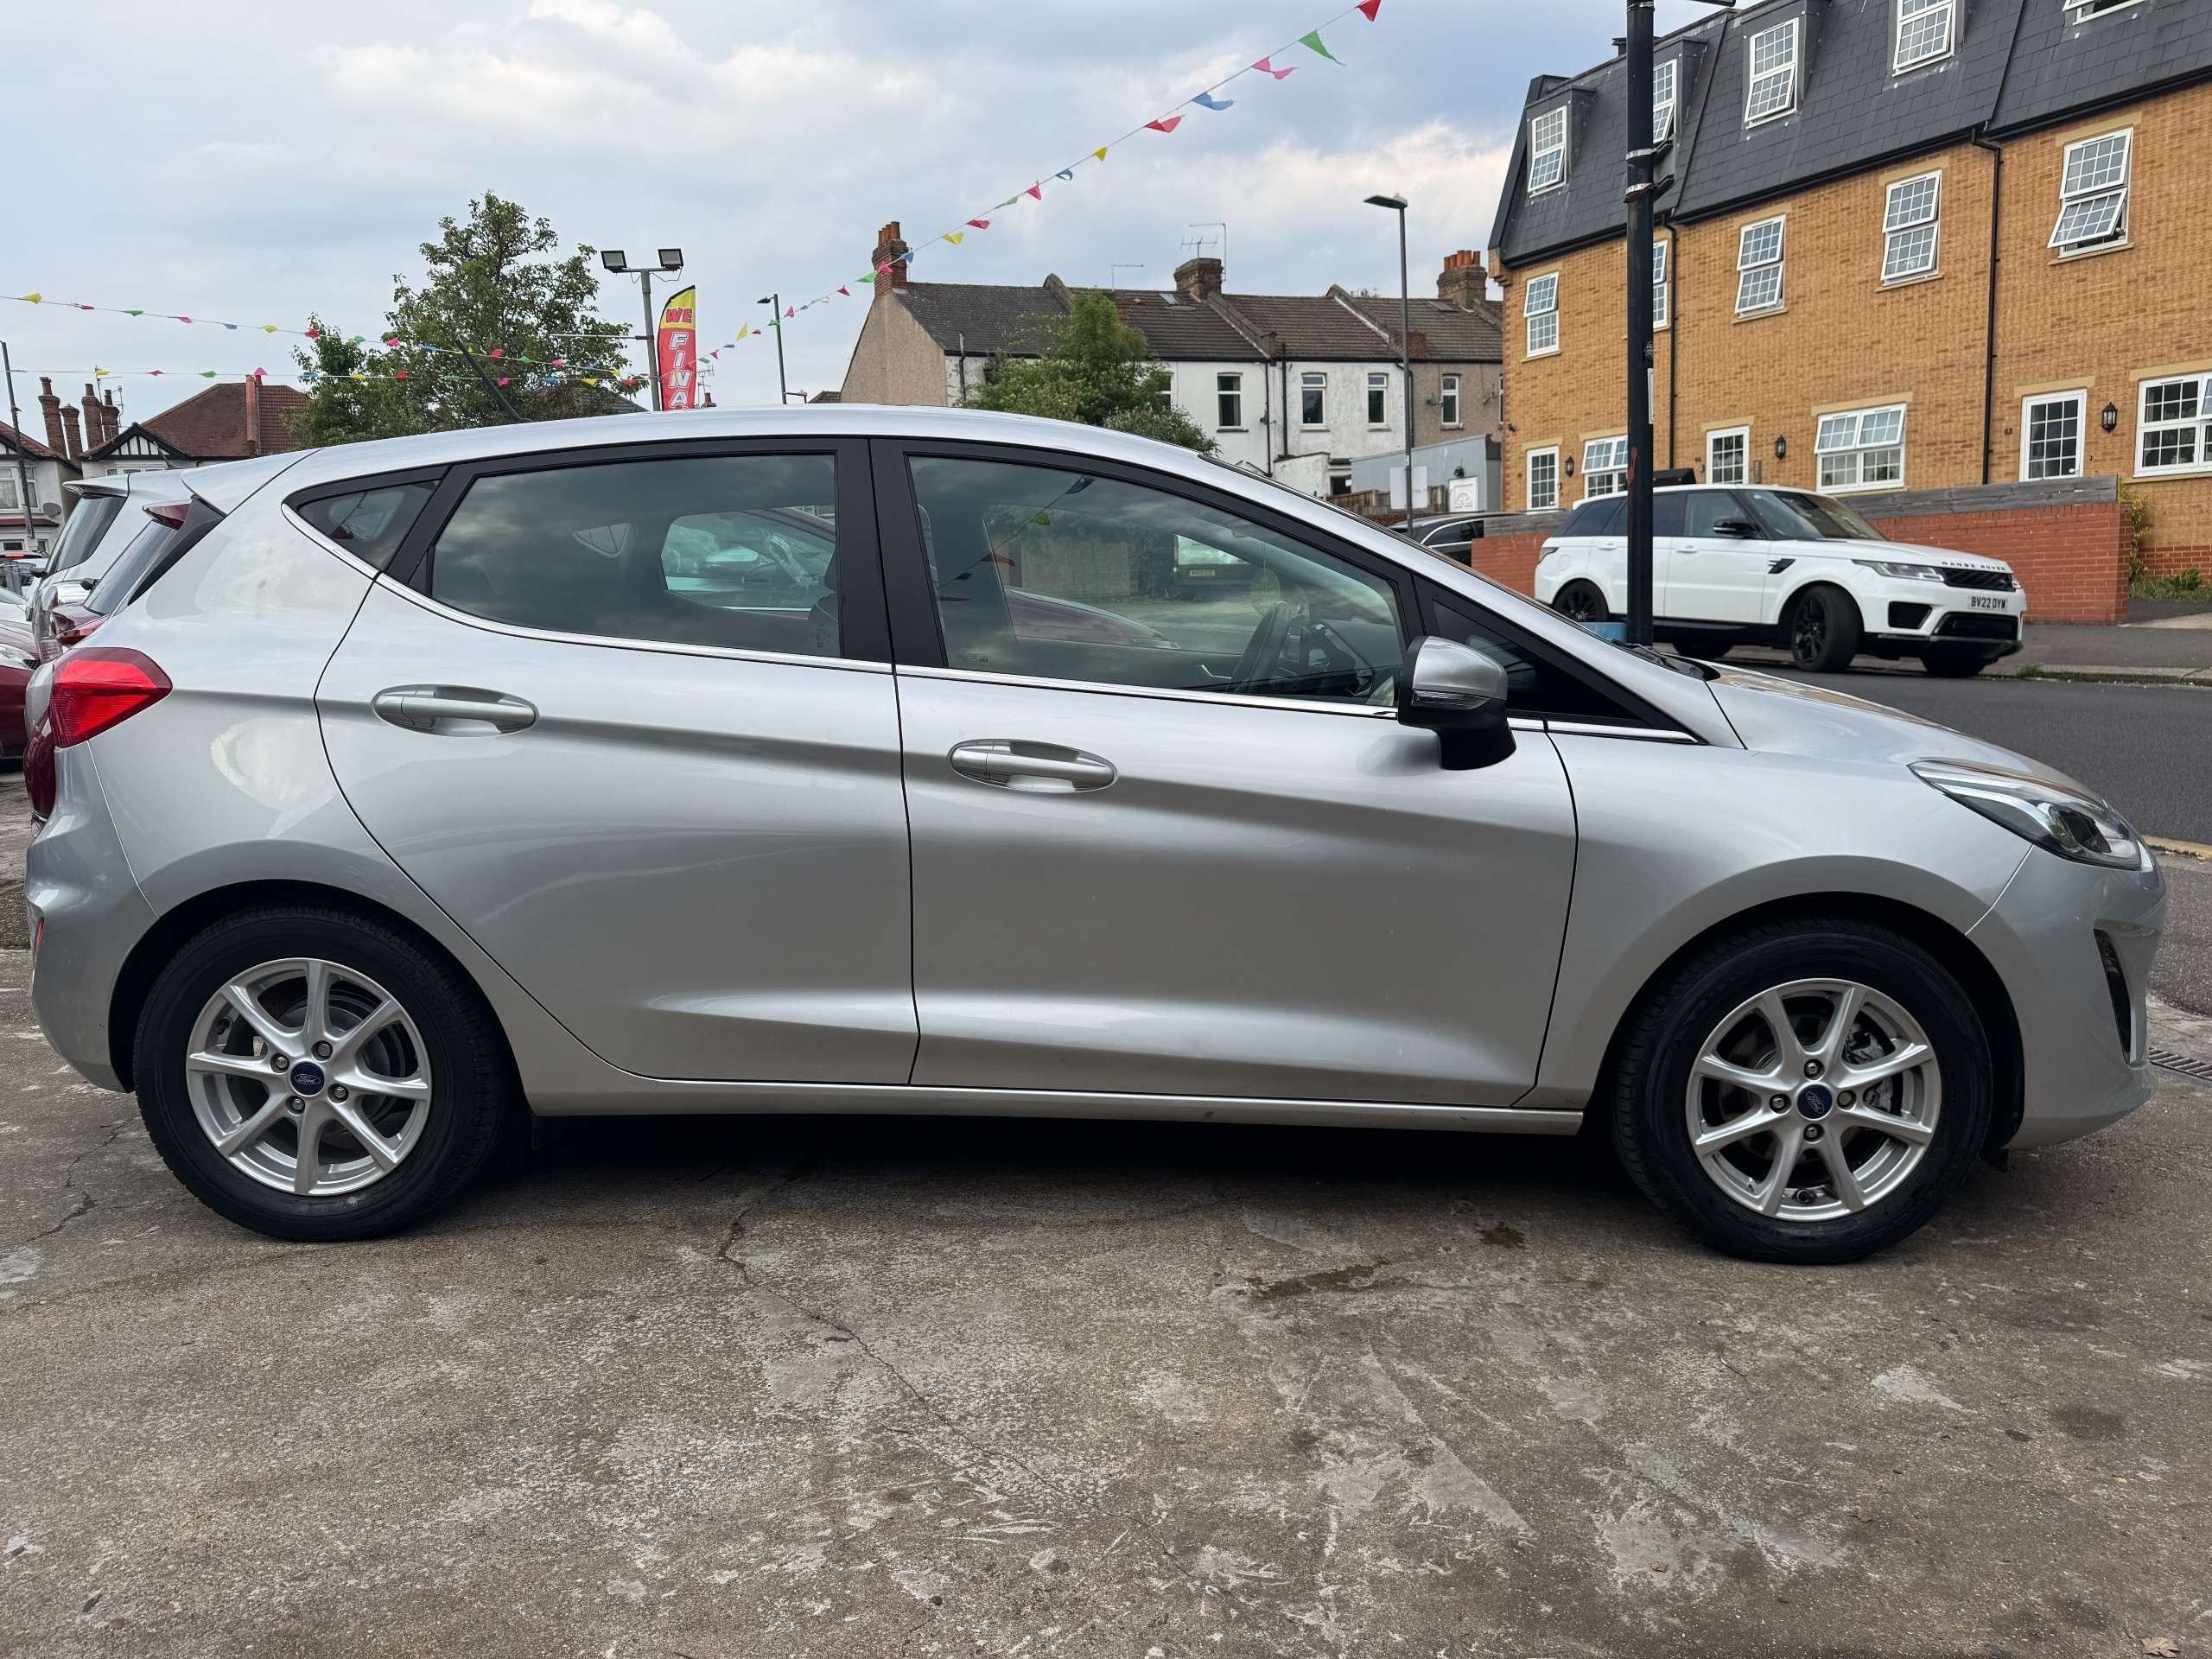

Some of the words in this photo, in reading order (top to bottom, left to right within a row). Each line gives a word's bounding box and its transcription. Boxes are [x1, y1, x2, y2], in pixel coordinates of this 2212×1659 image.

[665, 307, 693, 324] WE
[1971, 596, 1991, 608] BV22
[296, 1075, 318, 1085] Ford
[1808, 1093, 1823, 1113] Ford
